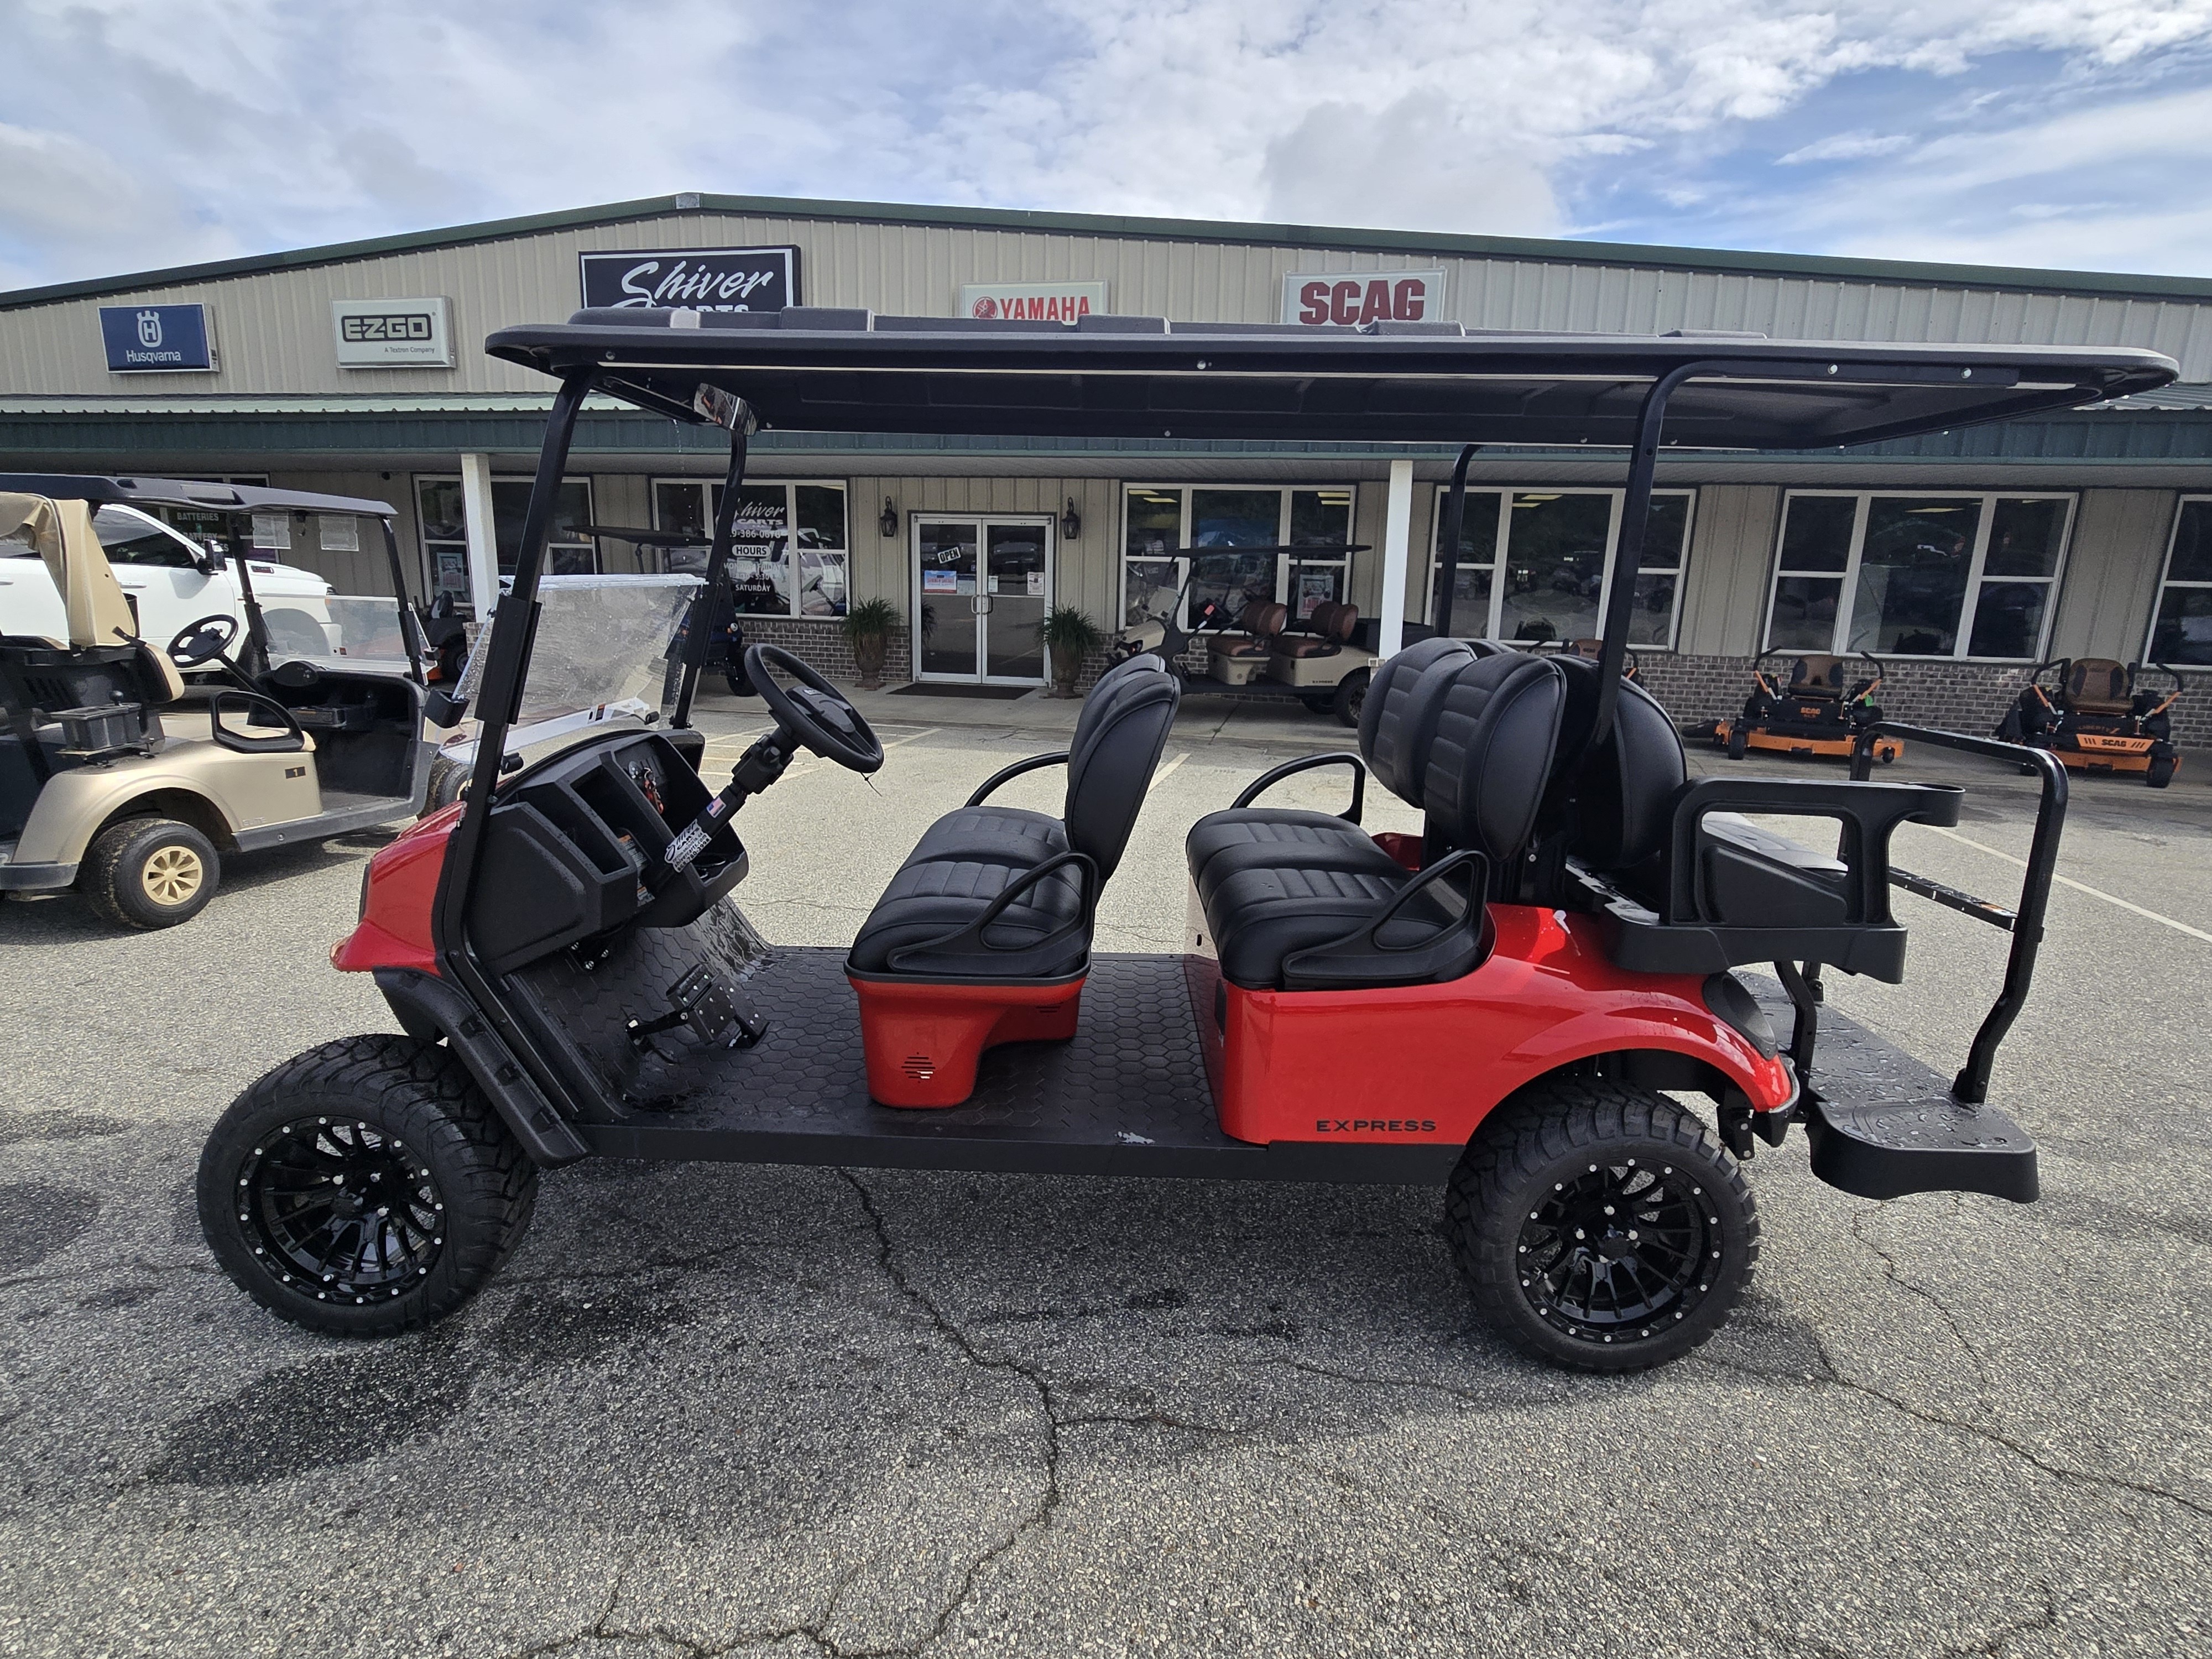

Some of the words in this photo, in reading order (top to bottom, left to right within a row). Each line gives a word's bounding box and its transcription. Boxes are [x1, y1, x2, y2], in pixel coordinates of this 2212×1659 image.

[611, 260, 774, 307] Shiver
[1000, 296, 1090, 321] YAMAHA
[1300, 279, 1426, 325] SCAG
[126, 350, 181, 364] Husqvarna
[733, 498, 785, 519] hiver
[177, 512, 219, 521] BATTERIES
[736, 546, 767, 555] HOURS
[940, 548, 959, 562] OPEN
[735, 584, 770, 592] SATURDAY
[293, 768, 298, 776] 1
[1316, 1120, 1436, 1132] EXPRESS
